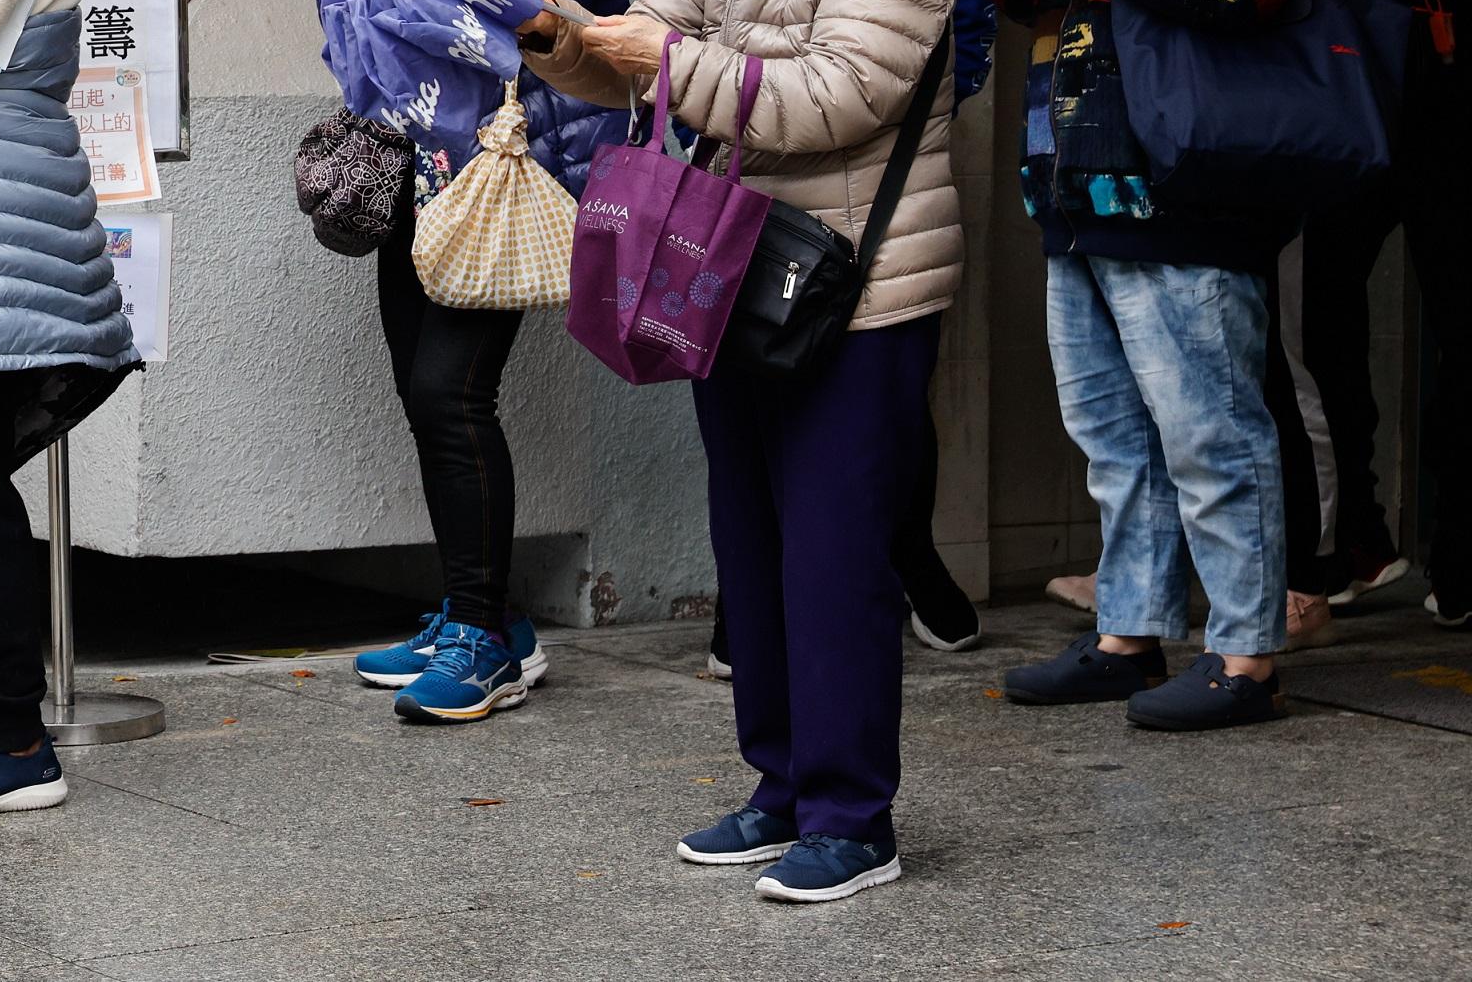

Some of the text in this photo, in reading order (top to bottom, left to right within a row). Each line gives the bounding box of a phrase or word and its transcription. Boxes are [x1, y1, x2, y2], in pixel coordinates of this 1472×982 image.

[84, 4, 136, 60] 籌
[79, 112, 132, 132] 以上的
